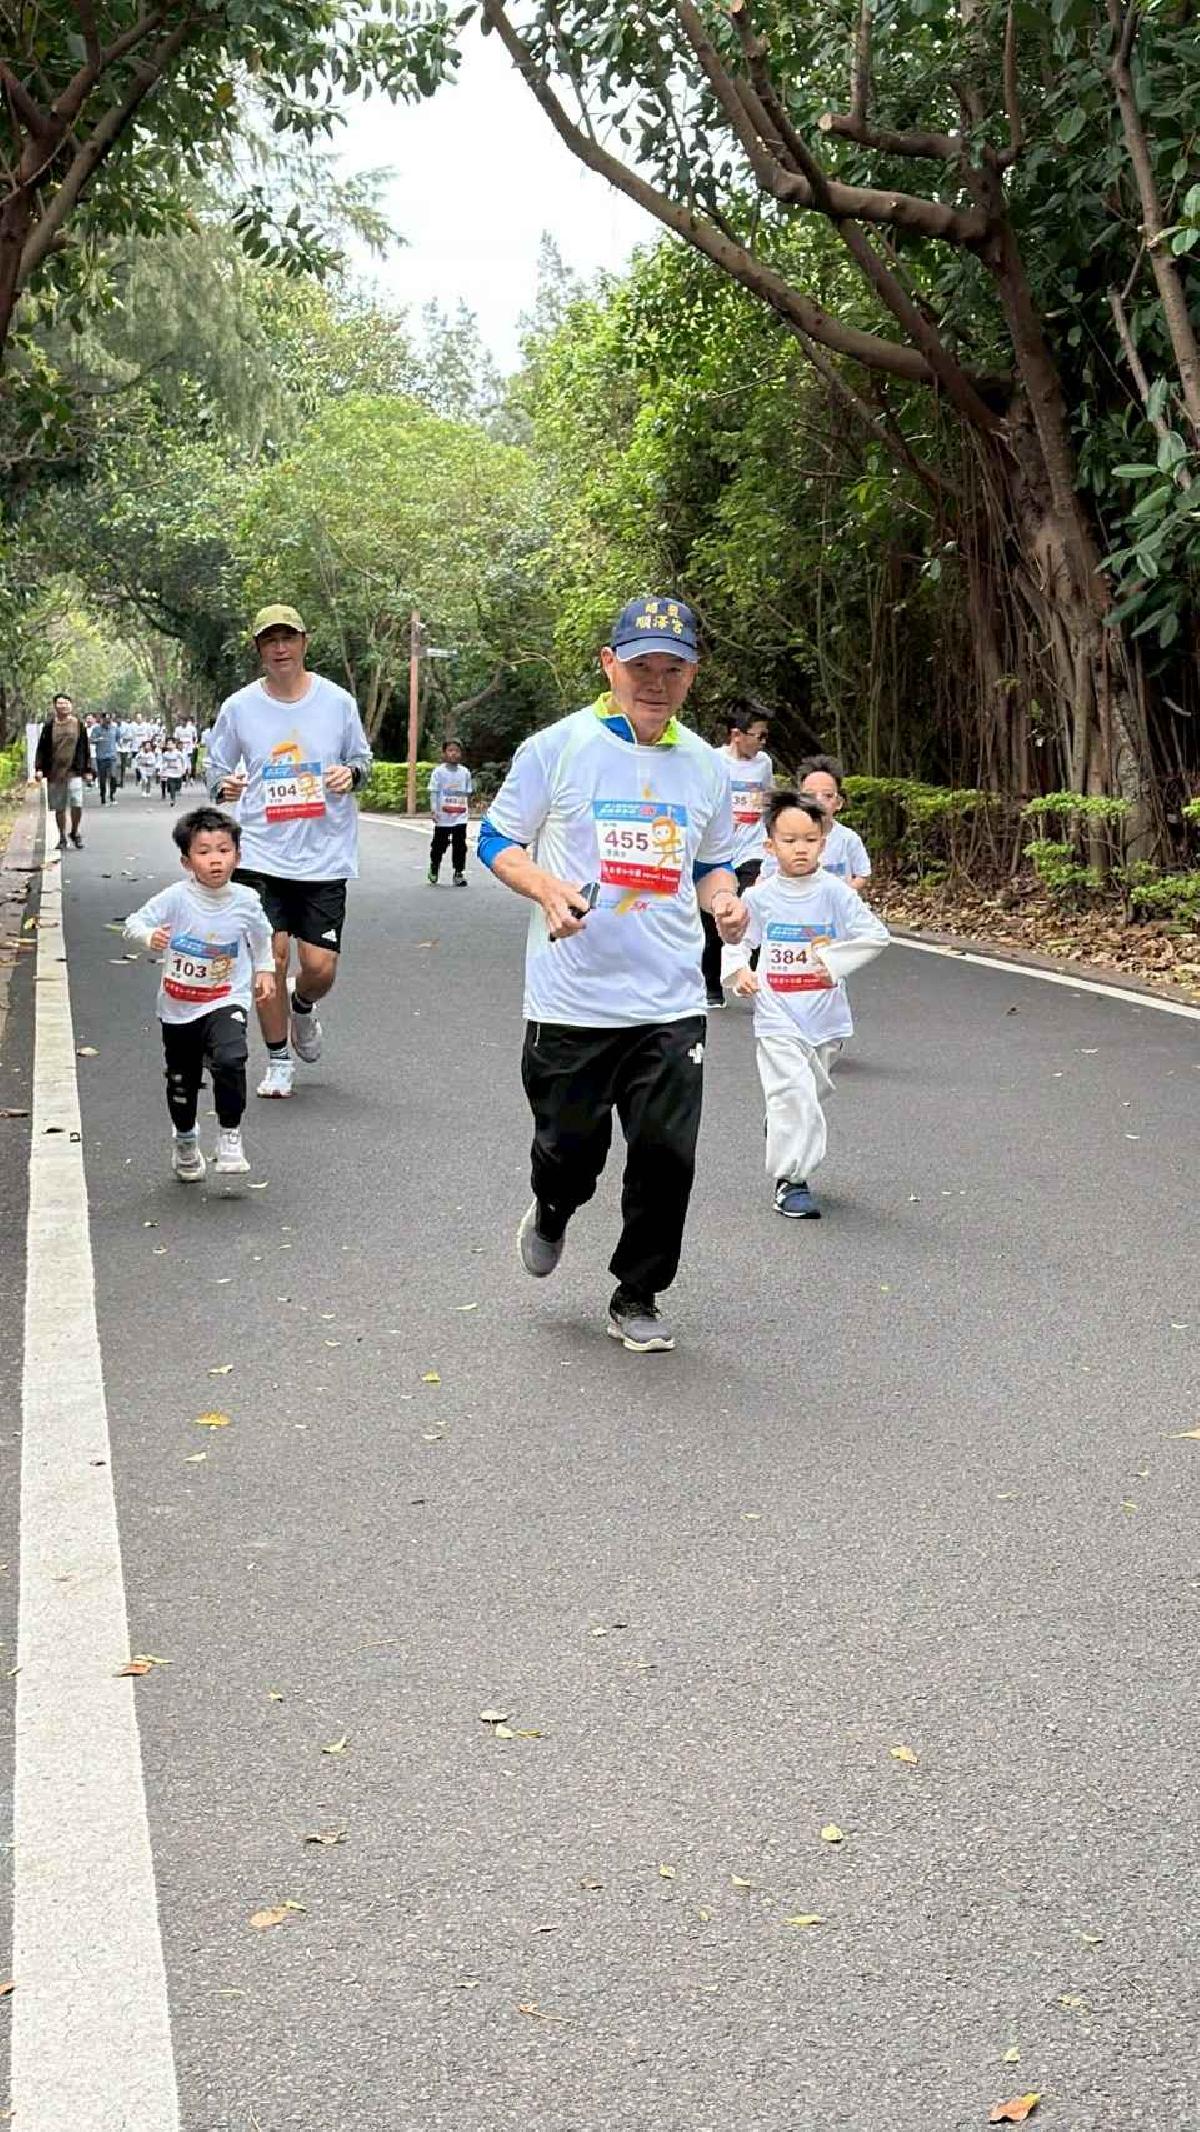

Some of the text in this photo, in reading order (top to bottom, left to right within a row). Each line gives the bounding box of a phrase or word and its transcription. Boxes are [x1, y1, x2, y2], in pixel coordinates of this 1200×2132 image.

[268, 783, 297, 798] 104
[604, 830, 649, 852] 455
[770, 949, 808, 964] 384
[172, 958, 207, 978] 103
